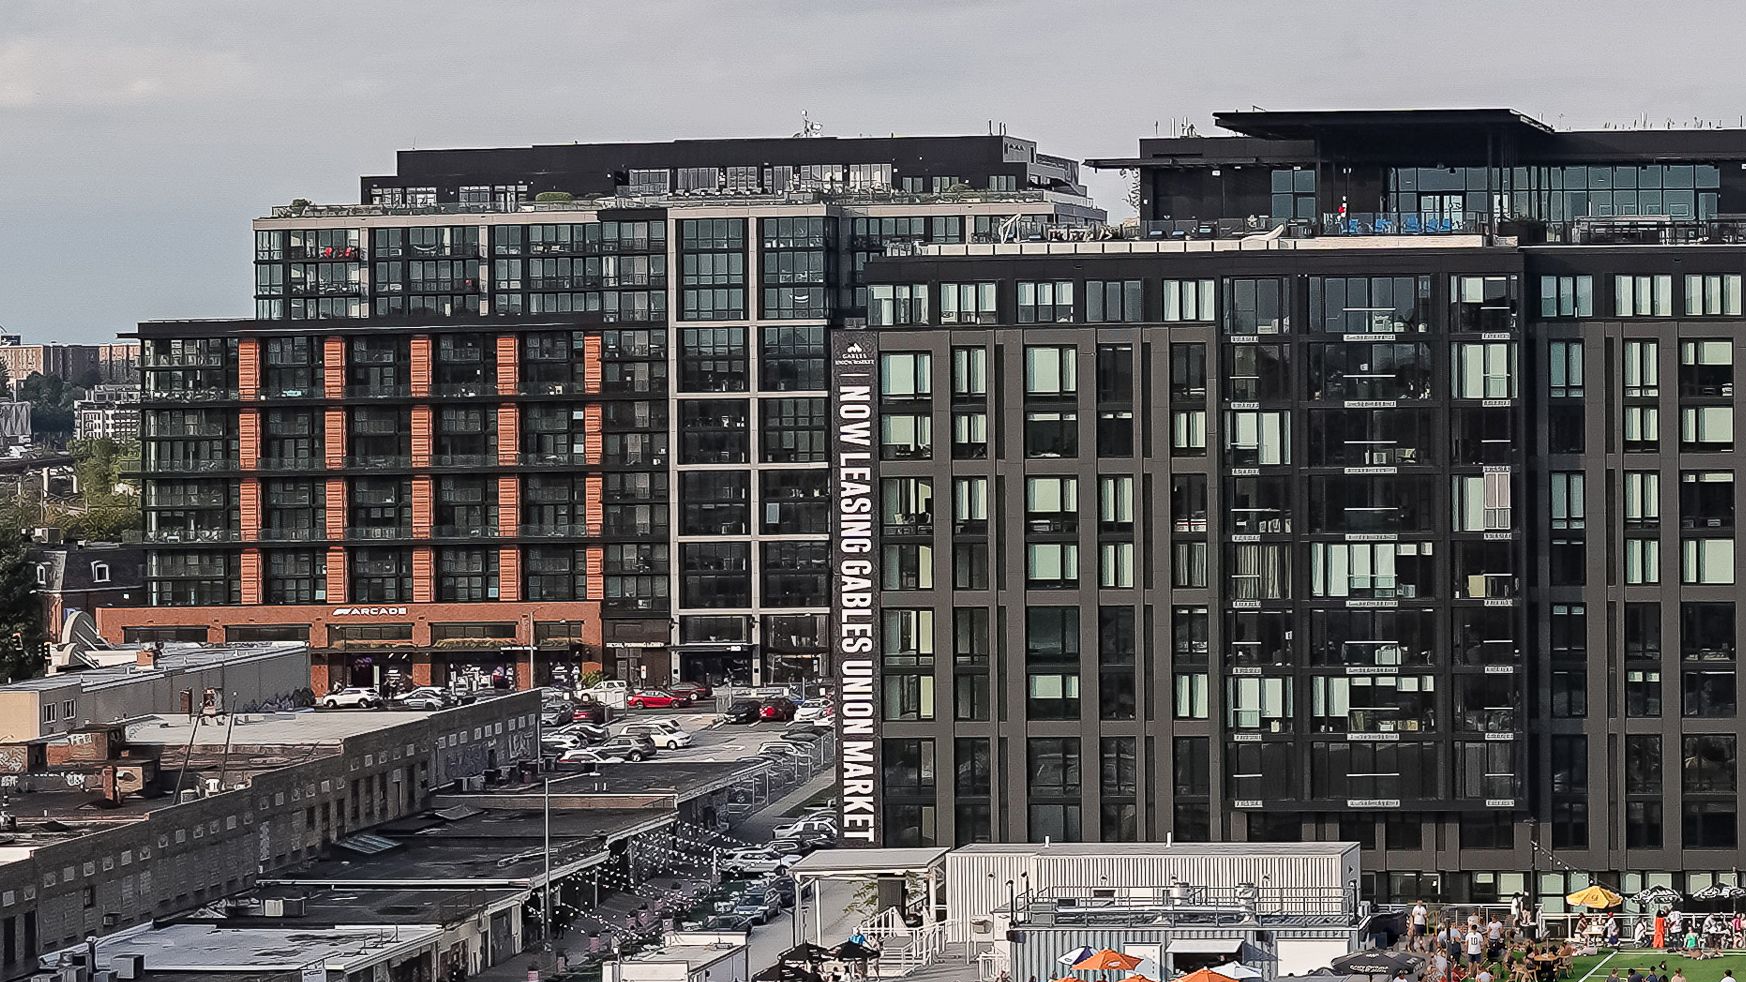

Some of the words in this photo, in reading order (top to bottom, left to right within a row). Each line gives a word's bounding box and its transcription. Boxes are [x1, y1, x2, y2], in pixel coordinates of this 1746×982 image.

[839, 385, 871, 446] NOW
[840, 452, 872, 553] LEASING
[351, 607, 407, 615] ARCADE
[841, 560, 873, 653] GABLES
[842, 660, 874, 735] UNION
[843, 741, 875, 843] MARKET
